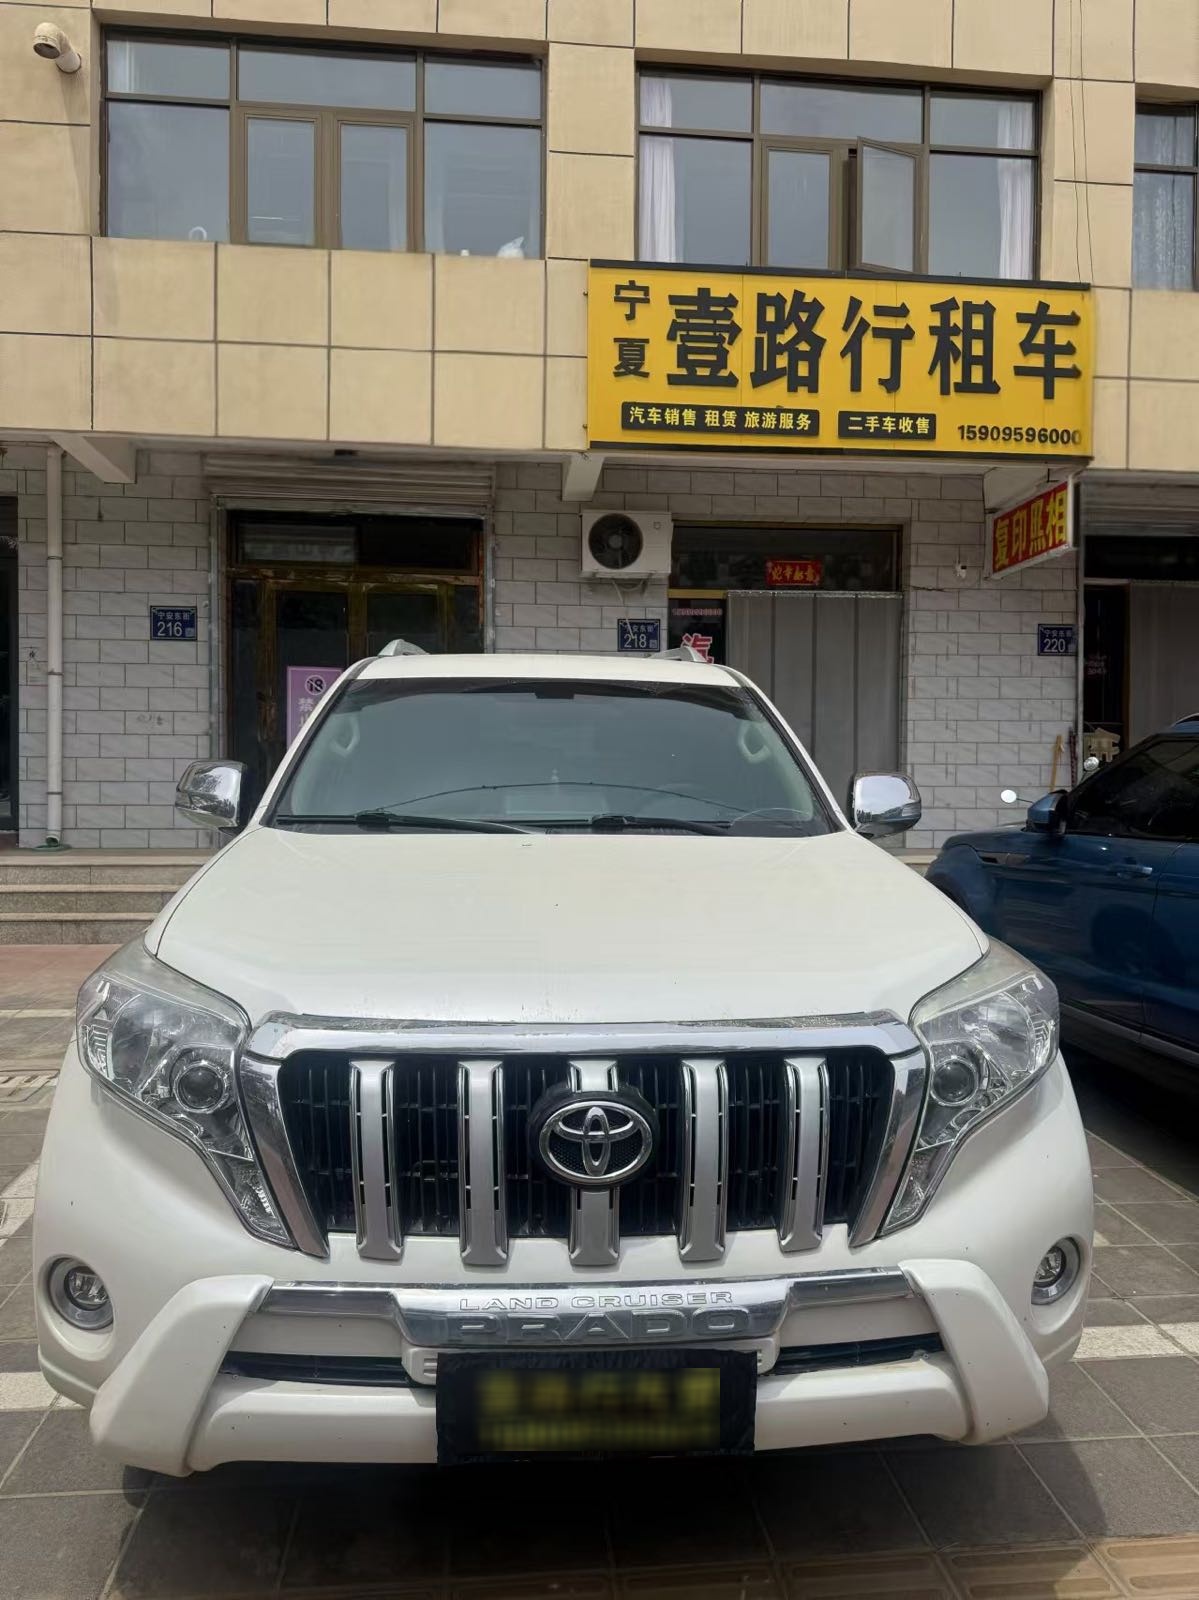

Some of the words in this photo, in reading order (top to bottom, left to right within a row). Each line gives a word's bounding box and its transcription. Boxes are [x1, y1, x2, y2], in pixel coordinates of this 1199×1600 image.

[613, 279, 650, 378] 宁夏
[666, 287, 1083, 400] 壹路行租车
[629, 406, 697, 427] 汽车销售
[704, 408, 737, 429] 租赁
[744, 411, 812, 431] 旅游服务
[847, 414, 931, 435] 二手车收售
[957, 424, 1082, 446] 15909596000
[157, 621, 183, 637] 216
[623, 633, 648, 649] 218
[1043, 638, 1066, 653] 220
[459, 1296, 559, 1311] LAND
[570, 1291, 733, 1308] CRUISER
[445, 1306, 750, 1341] PRADO
